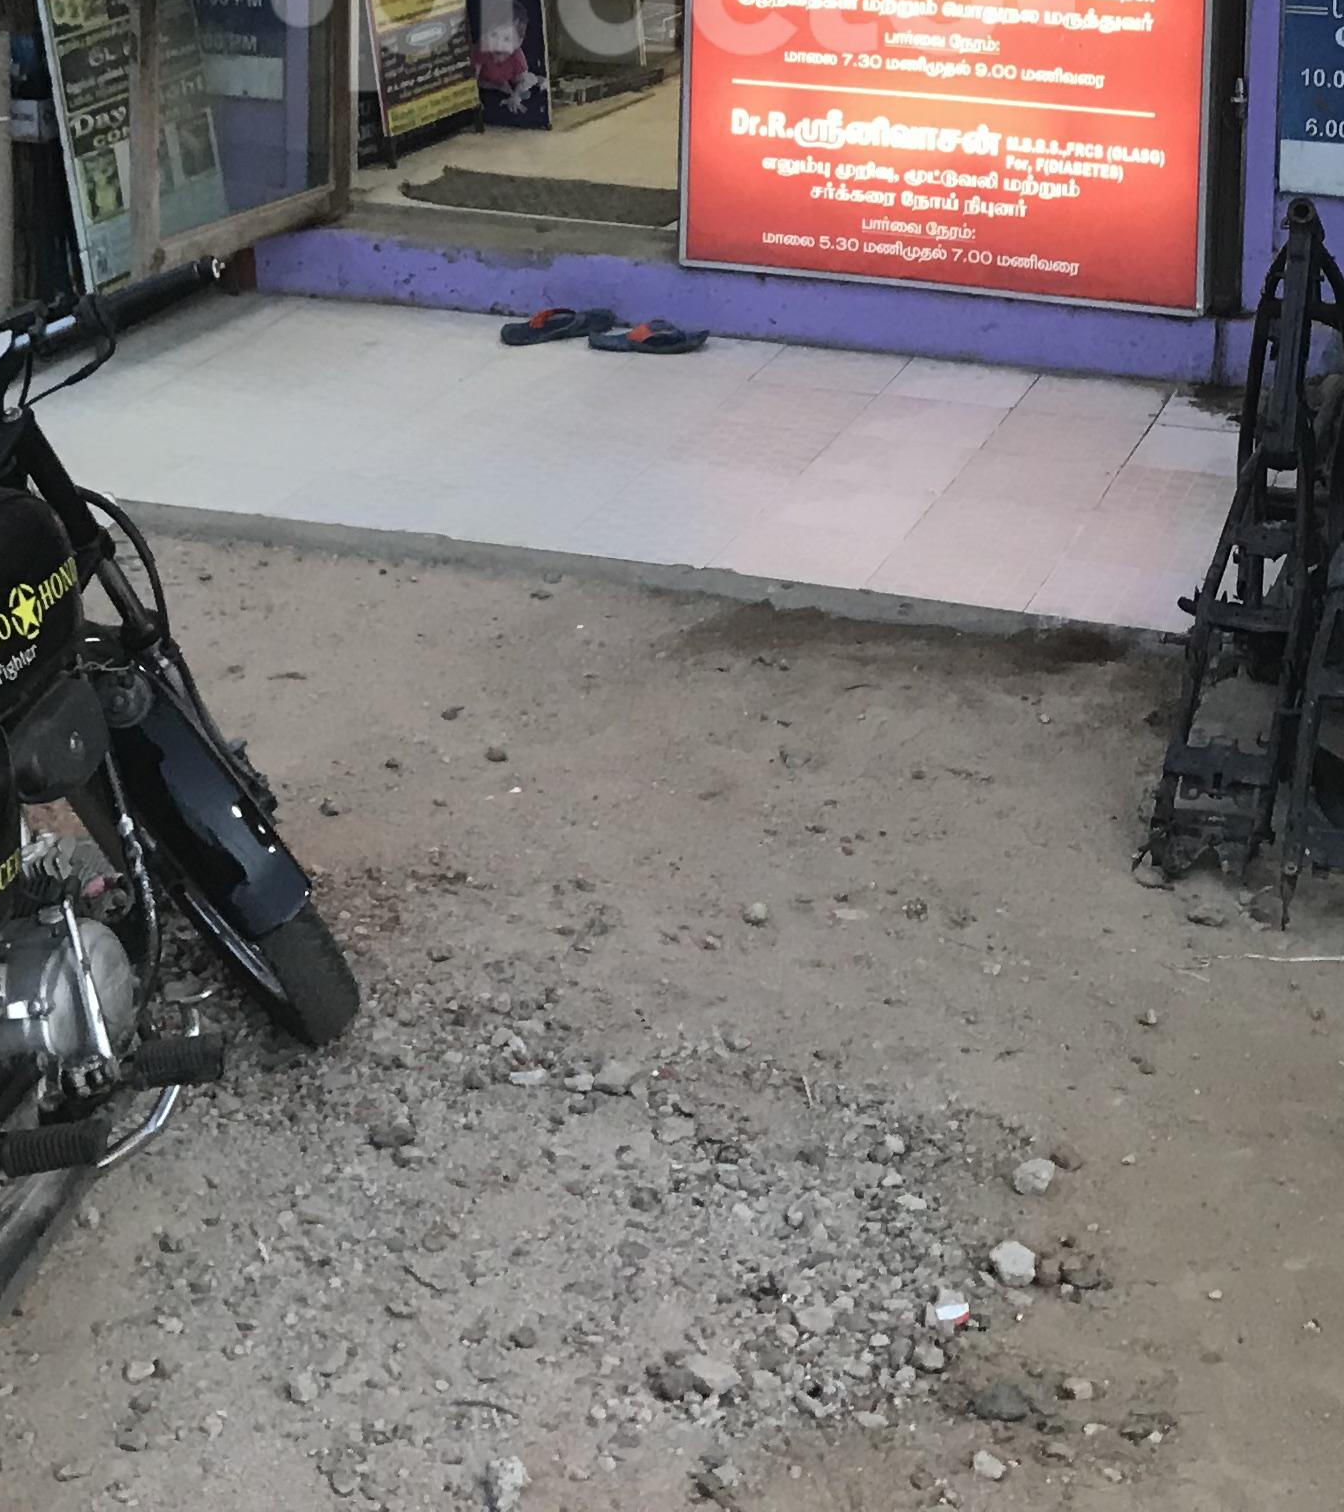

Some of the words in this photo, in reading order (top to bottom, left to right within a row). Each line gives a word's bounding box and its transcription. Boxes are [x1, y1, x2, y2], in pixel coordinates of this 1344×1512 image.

[841, 52, 883, 70] 7.30
[974, 62, 1017, 81] 9.00
[69, 105, 128, 139] Day
[861, 215, 923, 235] பார்வை
[761, 231, 816, 249] மாலை
[818, 236, 860, 253] 5.30
[951, 248, 993, 266] 7.00
[996, 253, 1081, 277] மணிவரை
